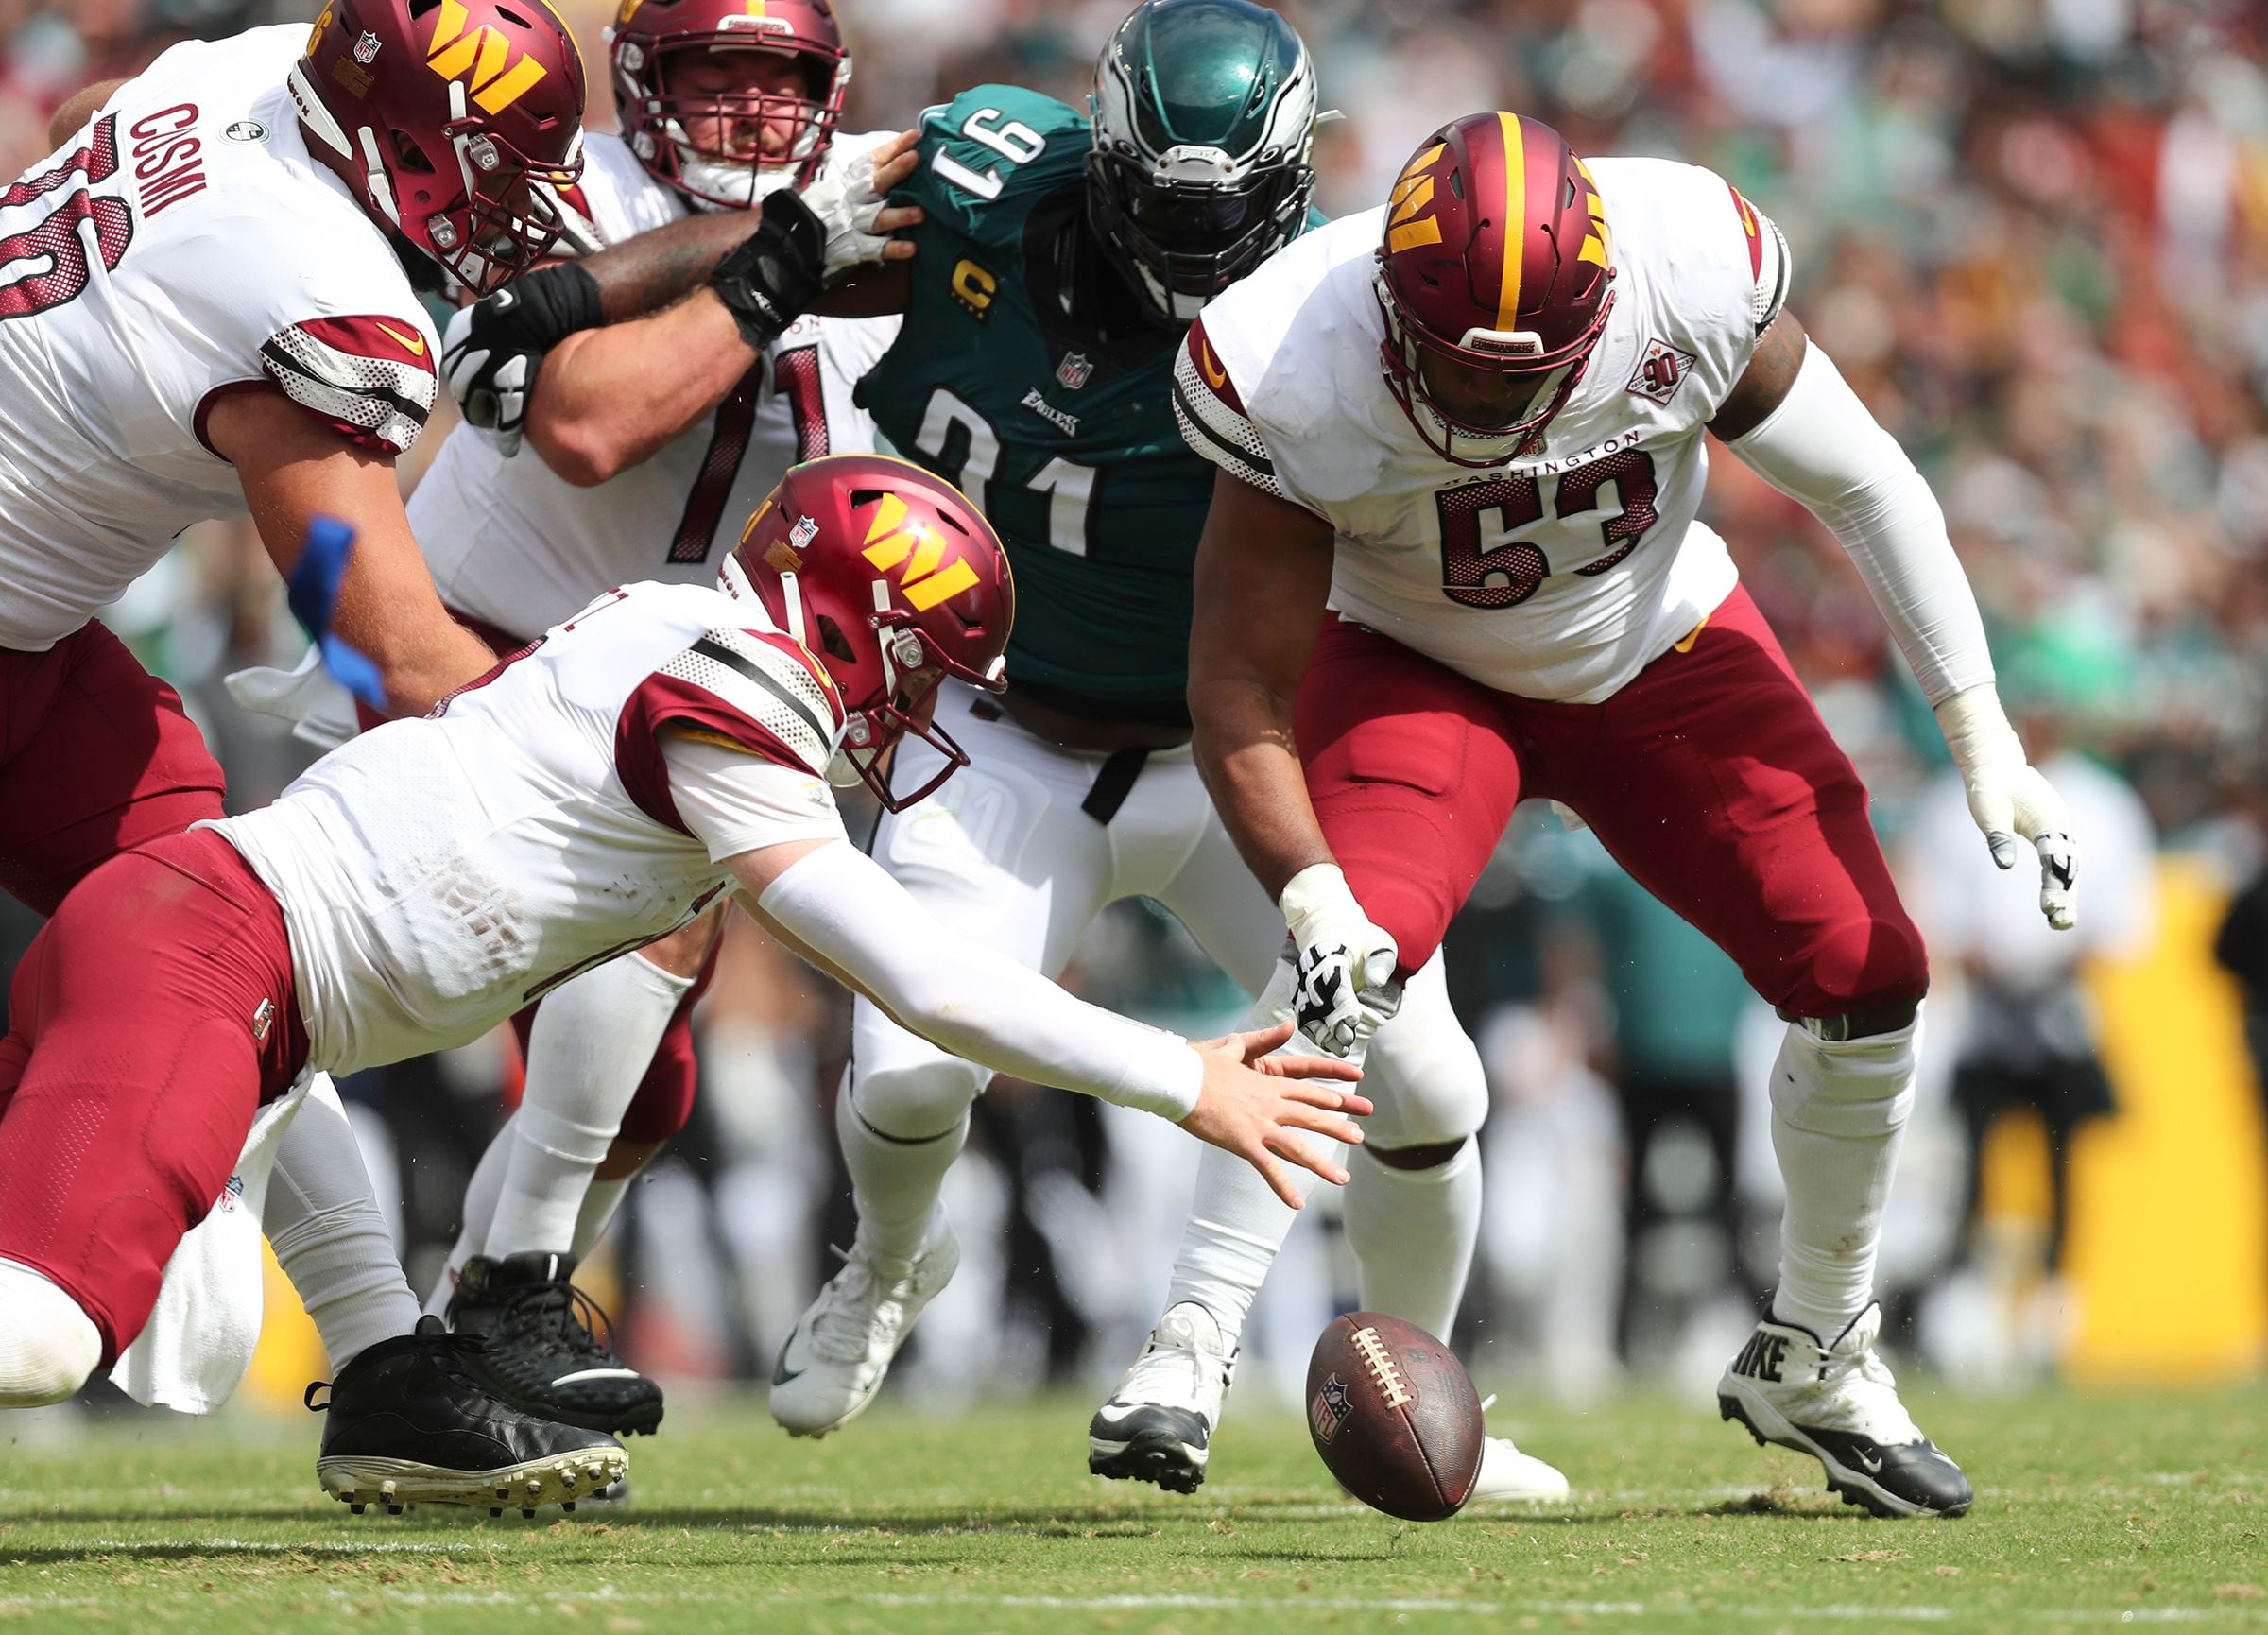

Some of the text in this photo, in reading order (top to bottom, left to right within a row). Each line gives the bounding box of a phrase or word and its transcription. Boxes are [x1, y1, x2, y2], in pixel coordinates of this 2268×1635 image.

[952, 259, 997, 309] C
[1643, 351, 1679, 393] 90
[1020, 386, 1082, 439] EAGLES
[1434, 447, 1660, 610] 53
